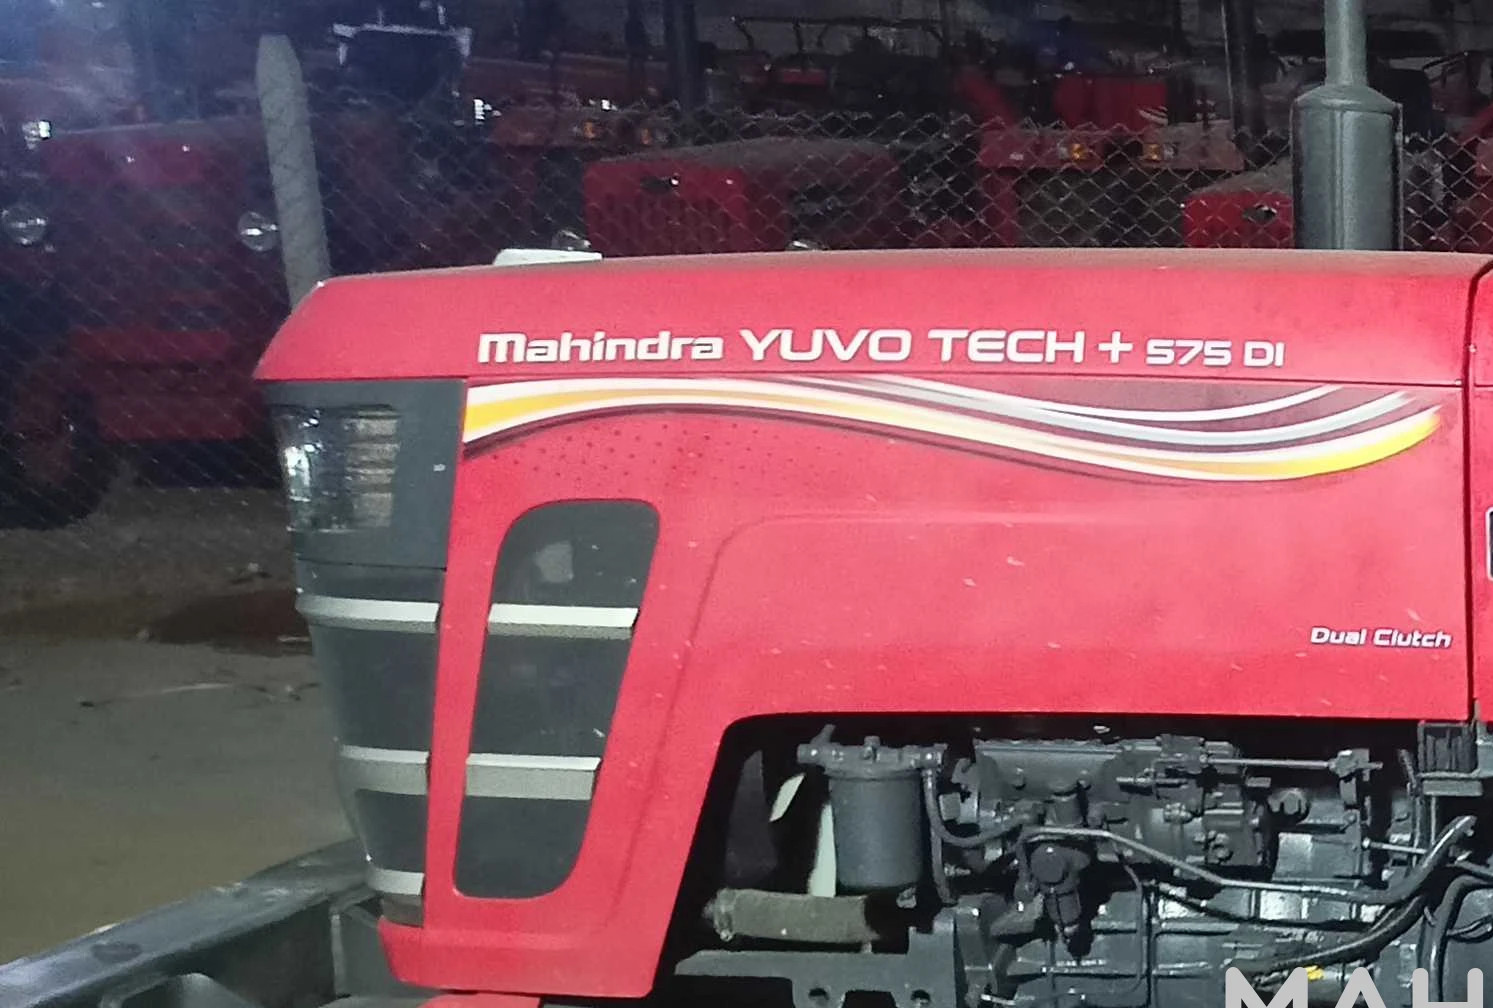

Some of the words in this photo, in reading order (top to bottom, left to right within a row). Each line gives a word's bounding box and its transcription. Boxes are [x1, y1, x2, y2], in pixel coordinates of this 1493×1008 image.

[477, 330, 725, 364] Mahindra
[738, 328, 912, 362] YUVO
[927, 329, 1086, 364] TECH
[1097, 331, 1134, 364] +
[1145, 339, 1232, 367] 575
[1243, 342, 1285, 367] DI
[1310, 626, 1367, 645] Dual
[1373, 628, 1452, 648] Clutch
